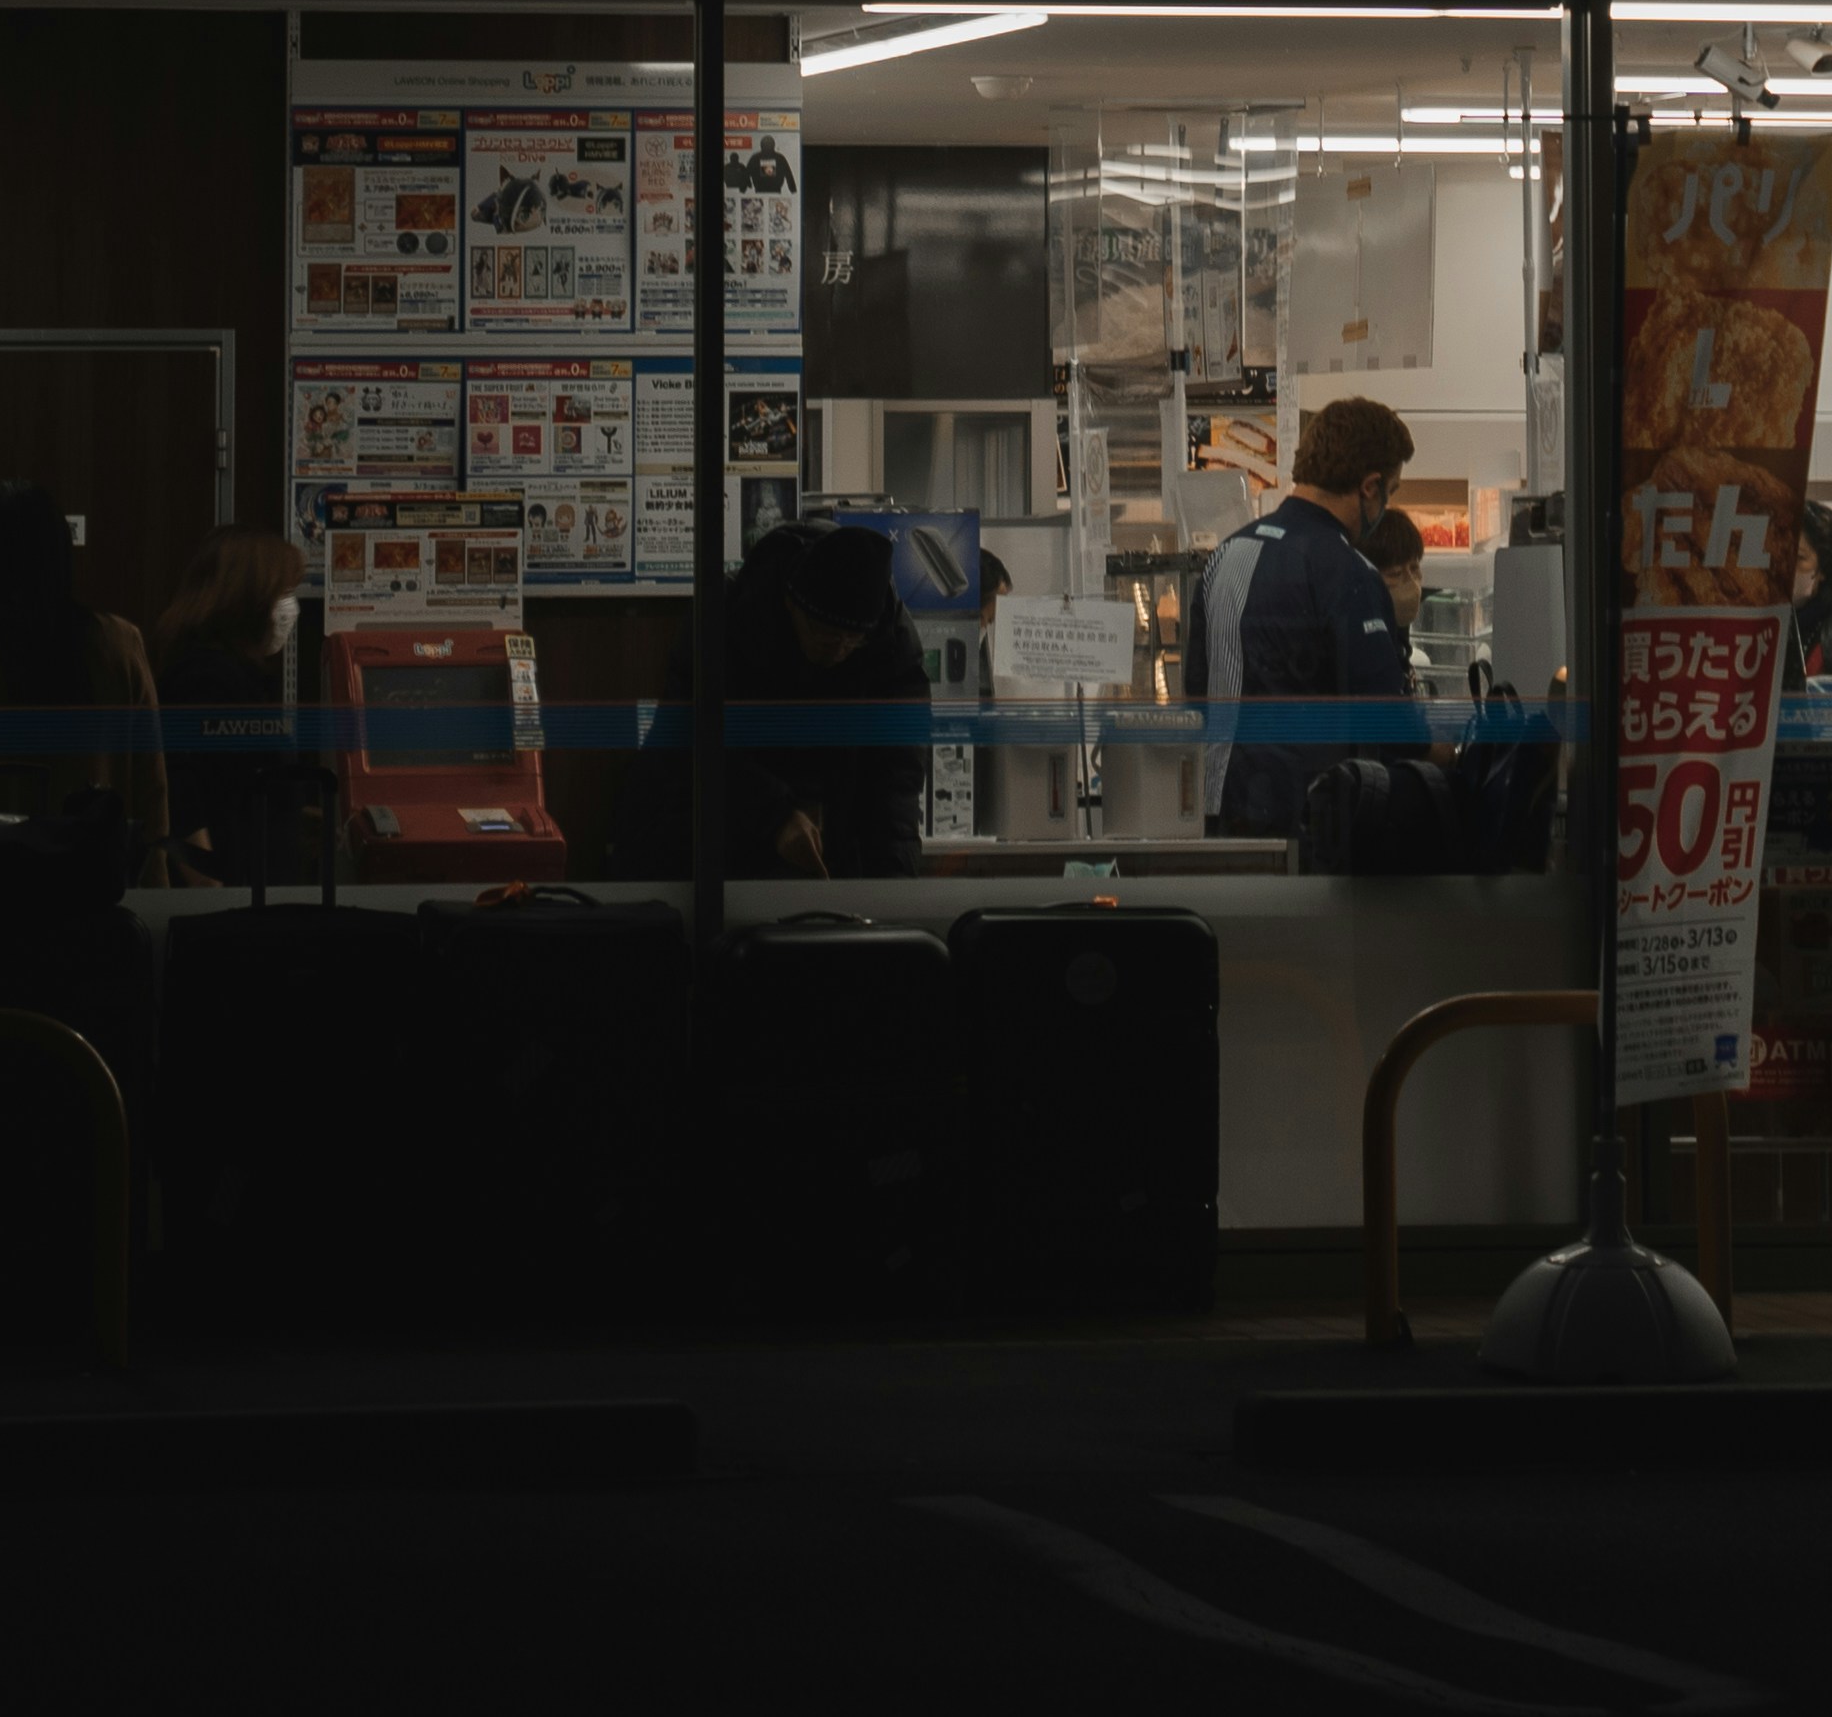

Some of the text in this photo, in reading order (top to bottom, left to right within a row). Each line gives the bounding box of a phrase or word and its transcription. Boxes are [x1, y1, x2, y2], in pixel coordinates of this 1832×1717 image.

[394, 77, 510, 89] LAWSON Online Shopping
[821, 251, 854, 285] 房
[650, 488, 687, 499] LILIUM
[1632, 485, 1772, 570] たん
[1623, 628, 1773, 684] 買うたび
[202, 719, 292, 736] LAWSON
[1622, 690, 1757, 742] もらえる
[1617, 760, 1721, 881] 50
[1769, 1040, 1825, 1061] ATM
